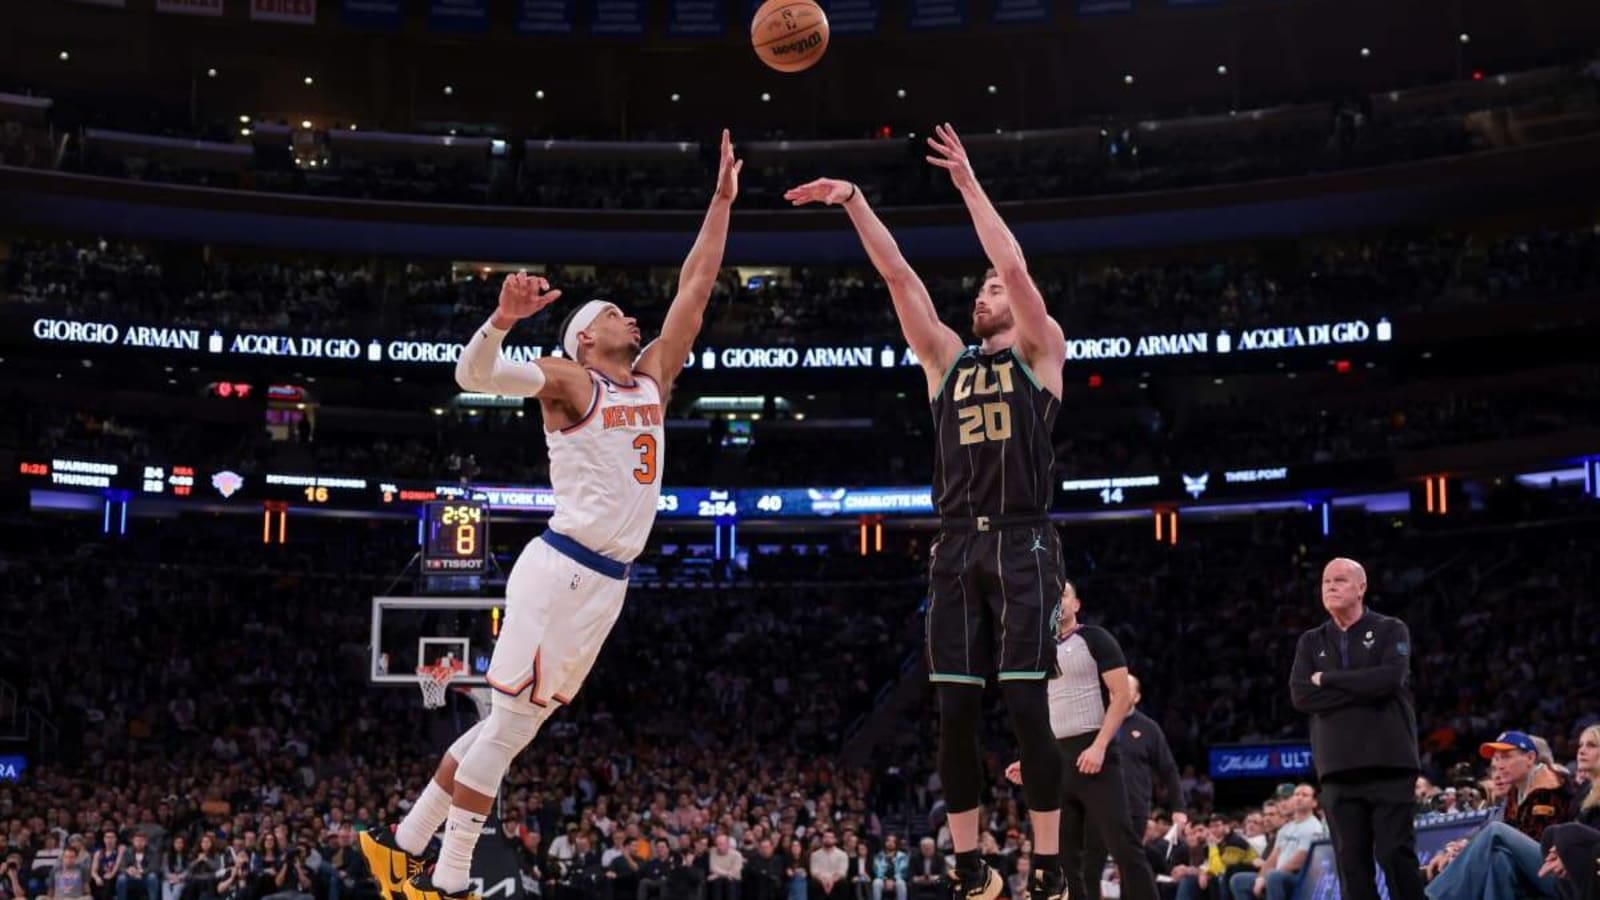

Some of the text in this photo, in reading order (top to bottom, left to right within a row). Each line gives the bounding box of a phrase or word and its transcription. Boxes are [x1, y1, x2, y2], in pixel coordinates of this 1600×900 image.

[33, 319, 200, 350] GIORGIO ARMANI
[1135, 332, 1208, 357] ARMANI
[1237, 326, 1305, 350] ACQUA
[1308, 324, 1330, 345] DI
[230, 334, 299, 356] ACQUA
[302, 338, 322, 357] DI
[388, 341, 465, 363] GIORGIO
[721, 347, 873, 368] GIORGIO ARMANI
[953, 360, 1015, 402] CLT
[958, 401, 1012, 446] 20
[53, 459, 118, 475] WARRIORS
[632, 433, 657, 485] 3
[52, 472, 110, 488] THUNDER
[304, 487, 329, 502] 16
[501, 493, 534, 505] YORK
[757, 495, 783, 512] 40
[845, 495, 911, 508] CHARLOTTE
[1100, 488, 1125, 504] 14
[442, 505, 480, 526] 2:54
[698, 500, 737, 517] 2:54
[456, 525, 475, 555] 8
[443, 559, 483, 569] TISSOT
